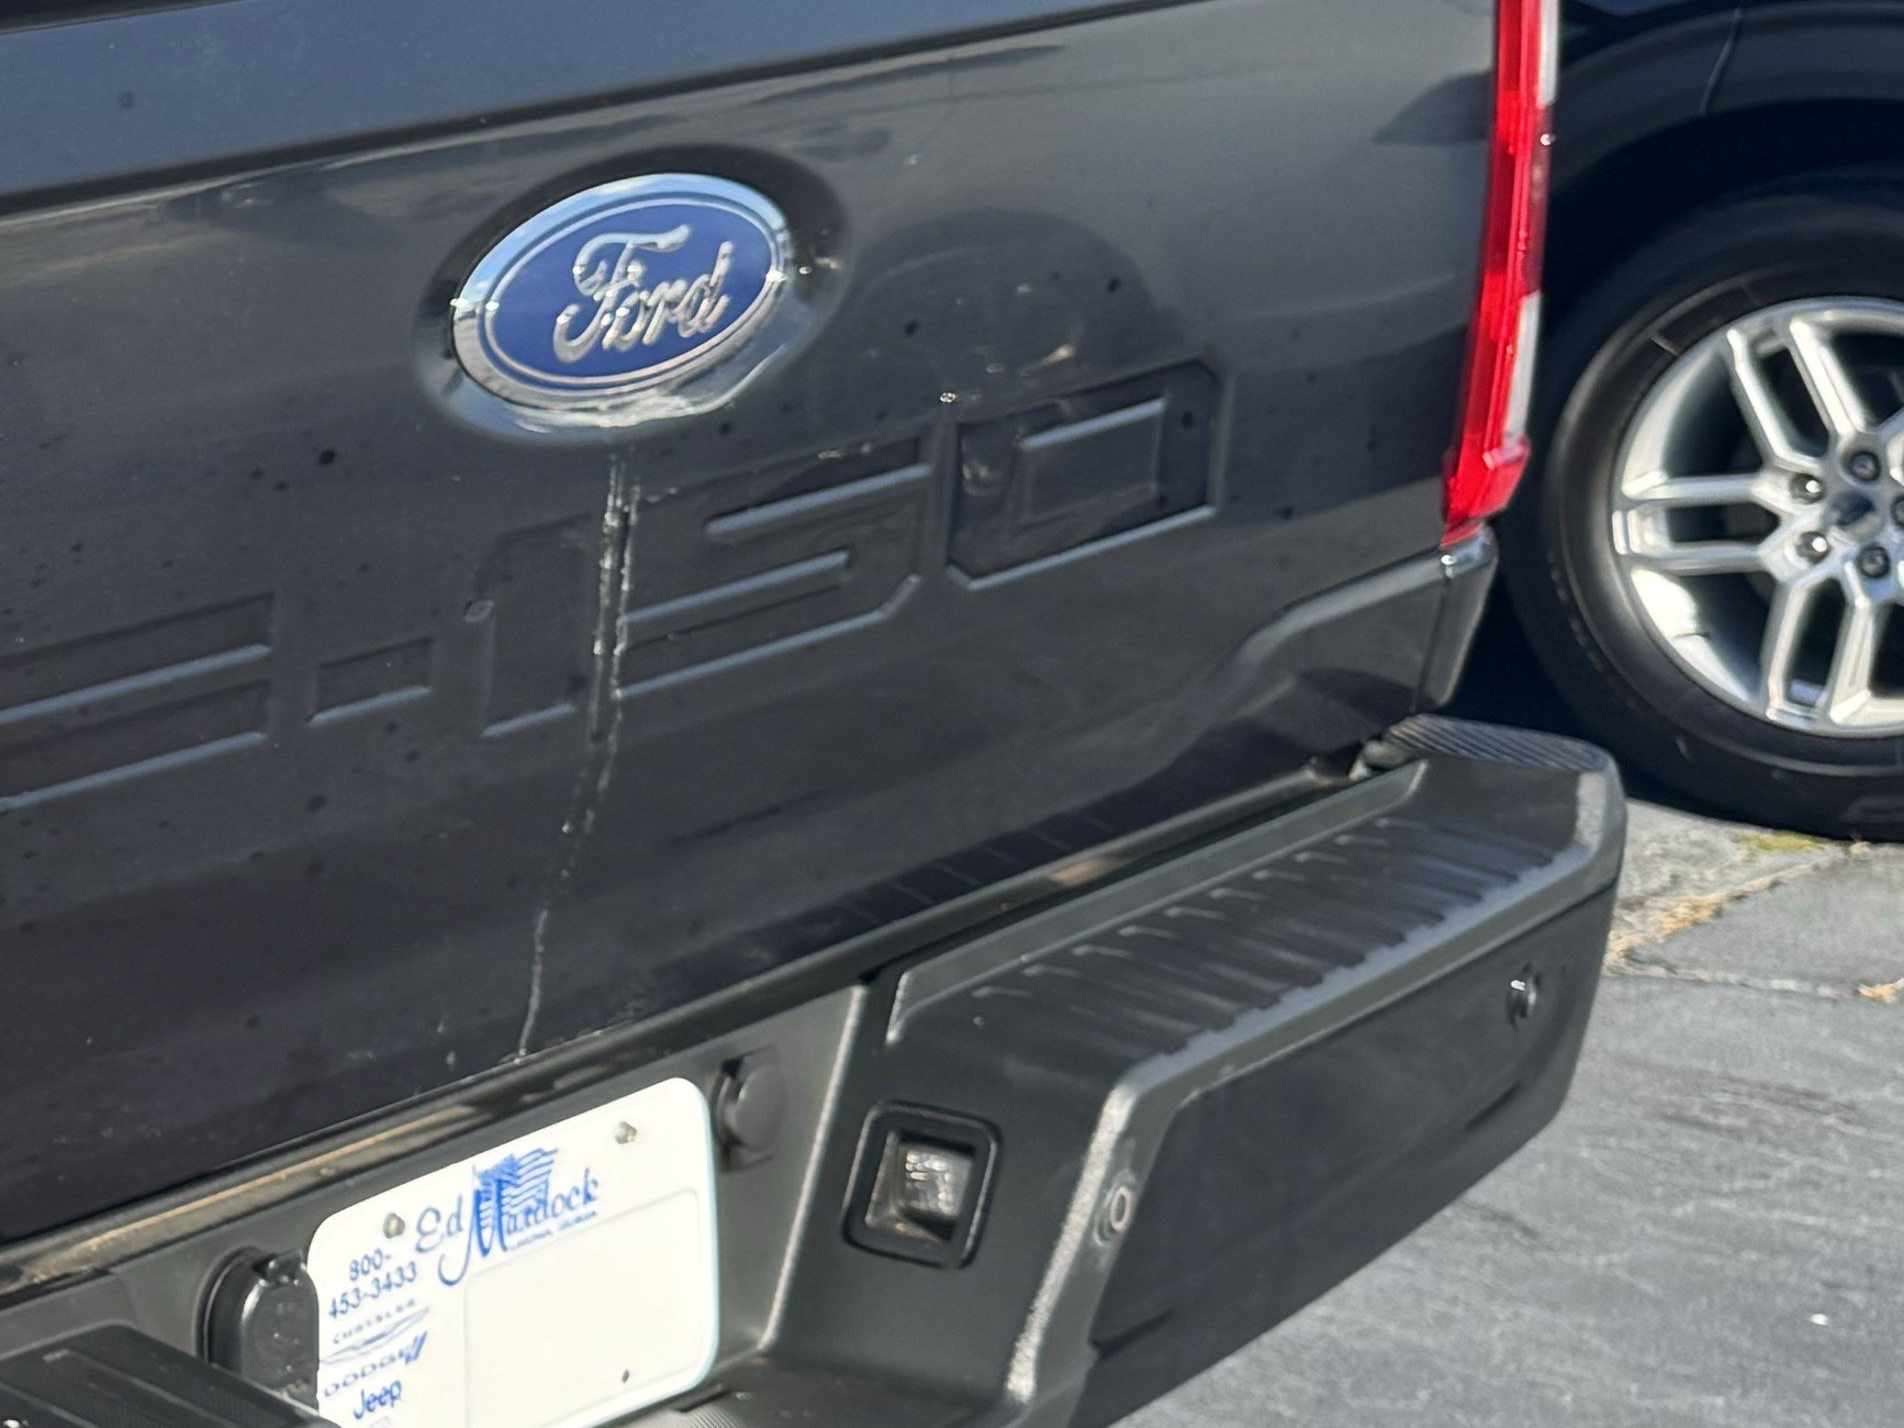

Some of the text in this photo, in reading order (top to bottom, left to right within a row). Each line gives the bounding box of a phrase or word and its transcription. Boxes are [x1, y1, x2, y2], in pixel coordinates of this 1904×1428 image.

[553, 224, 734, 363] Ford
[415, 1194, 463, 1252] Ed
[438, 1167, 598, 1286] Murdock
[353, 1380, 402, 1420] Jeep
